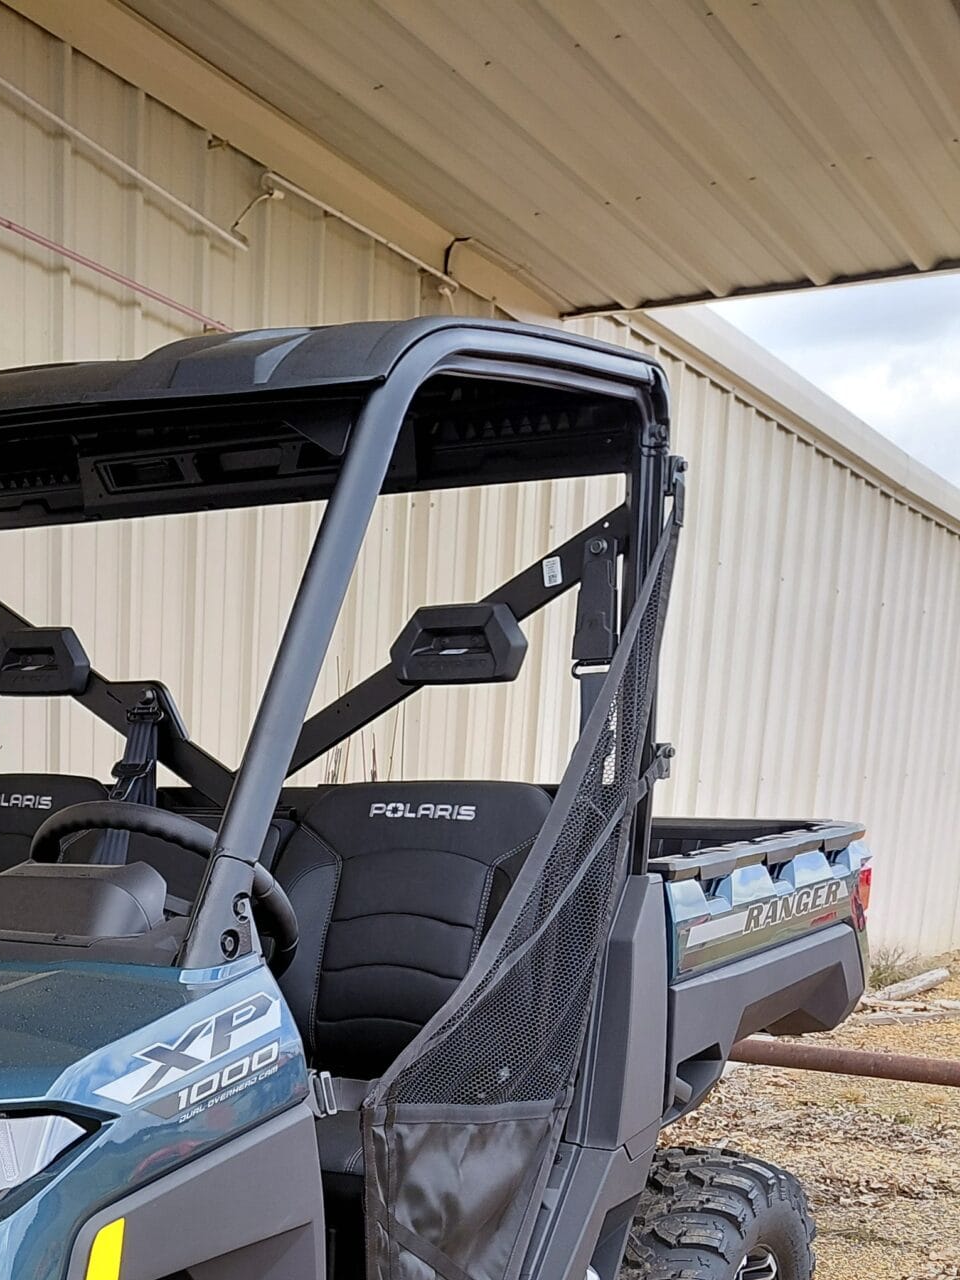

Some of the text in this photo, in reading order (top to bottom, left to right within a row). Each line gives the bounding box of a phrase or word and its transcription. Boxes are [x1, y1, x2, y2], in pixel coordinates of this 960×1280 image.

[368, 802, 477, 821] POLARIS
[742, 880, 841, 935] RANGER
[132, 992, 274, 1101] XP
[177, 1041, 280, 1111] 1000
[178, 1066, 279, 1124] DUAL OVERHEAD CAM
